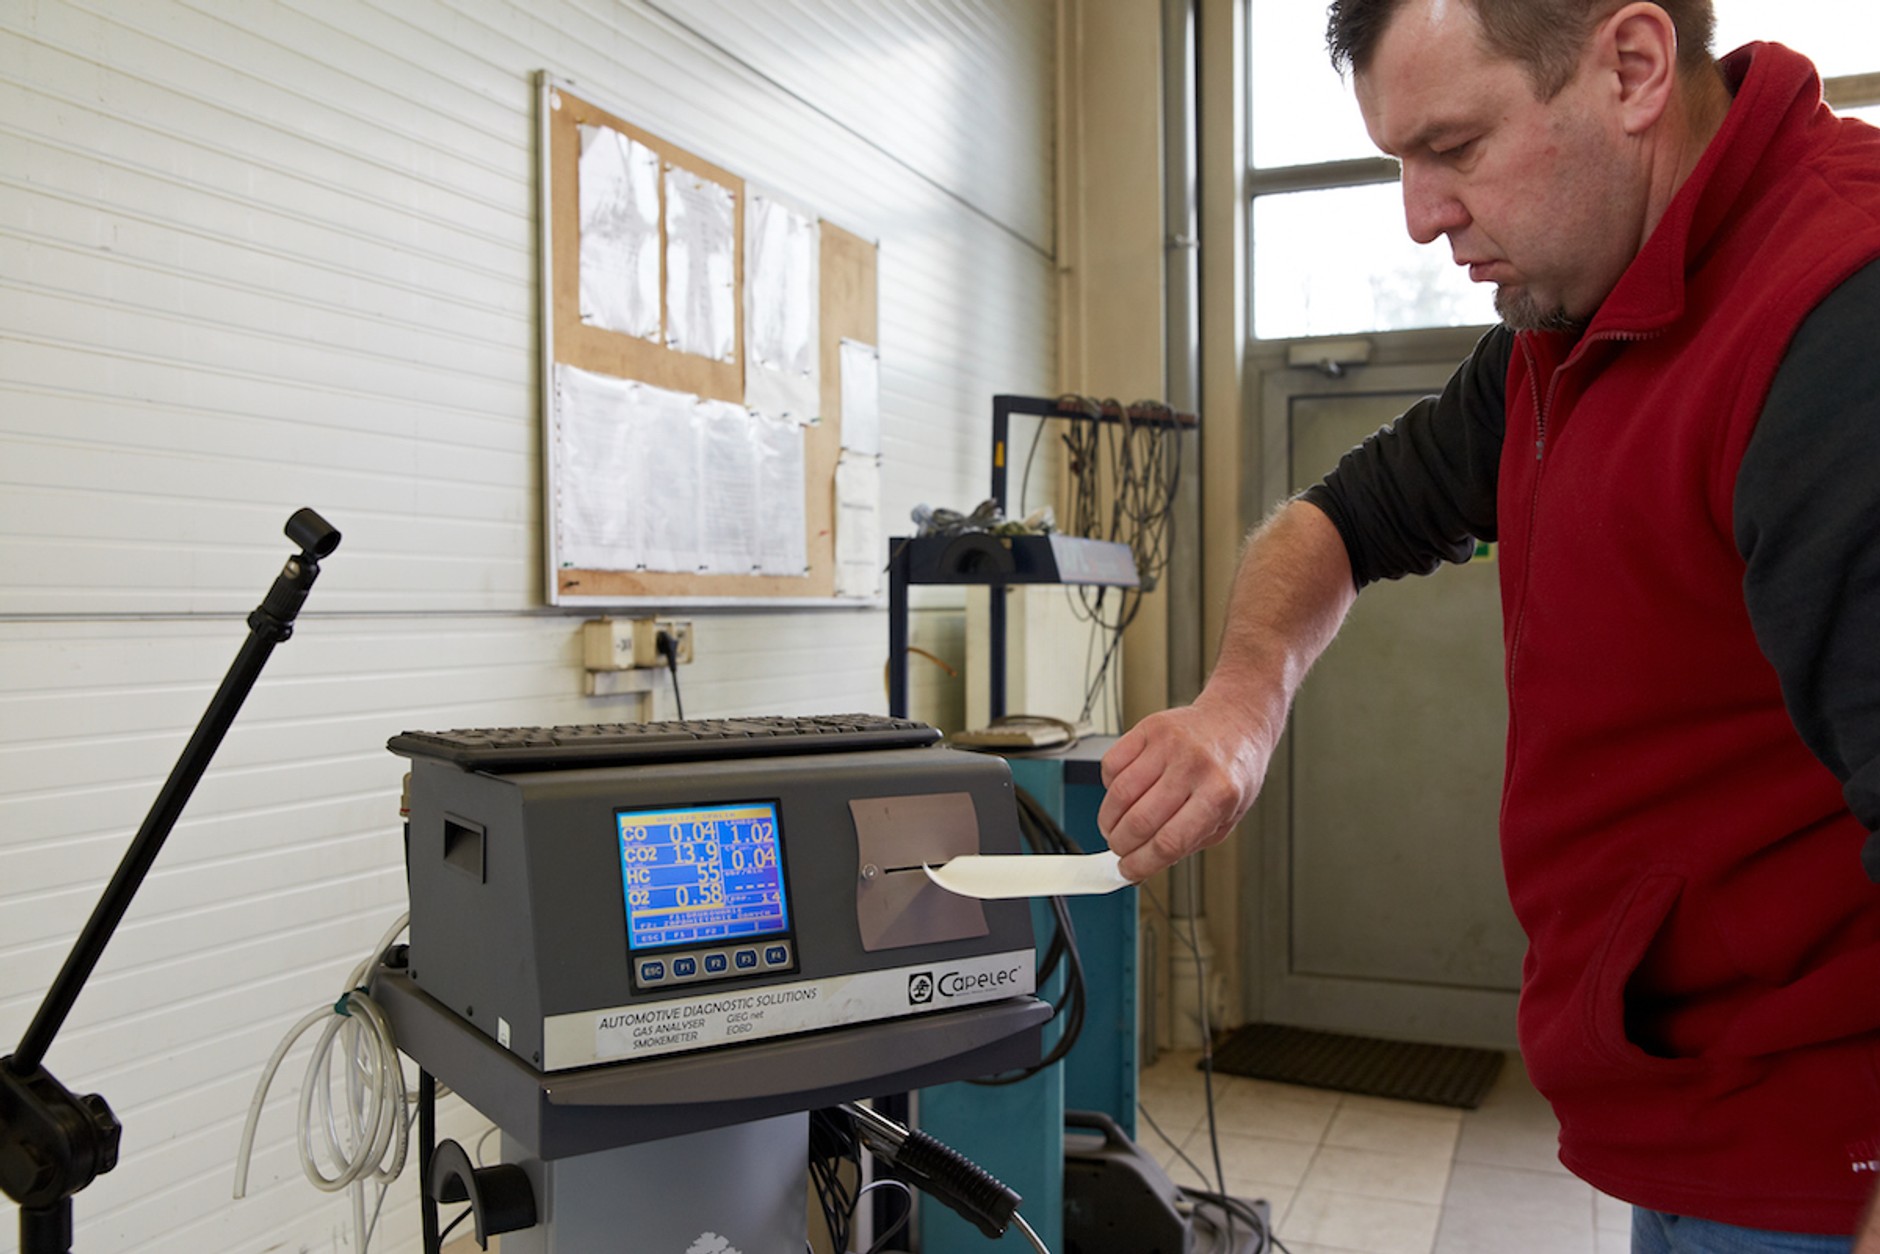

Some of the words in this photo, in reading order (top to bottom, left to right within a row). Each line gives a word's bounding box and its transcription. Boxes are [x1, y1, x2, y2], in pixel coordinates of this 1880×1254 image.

[623, 826, 647, 841] CO
[670, 822, 715, 844] 0.04
[731, 822, 774, 844] 1.02
[624, 846, 657, 863] CO2
[673, 841, 718, 864] 13.9
[732, 847, 776, 870] 0.04
[627, 868, 651, 884] HC
[697, 862, 721, 883] 55
[629, 890, 650, 906] O2
[676, 883, 722, 907] 0.58
[642, 934, 660, 942] ESC
[674, 931, 685, 939] F1
[680, 962, 691, 971] F1
[711, 958, 721, 968] F2
[741, 955, 752, 964] F3
[644, 965, 662, 976] ESC
[937, 967, 1018, 997] Capelec
[599, 1007, 681, 1030] AUTOMOTIVE
[683, 996, 753, 1018] DIAGNOSTIC
[755, 987, 818, 1007] SOLUTIONS
[750, 1010, 764, 1020] net
[633, 1025, 652, 1037] GAS
[655, 1018, 705, 1034] ANALYSER
[726, 1023, 753, 1036] EOBD
[633, 1031, 698, 1050] SMOKEMETER
